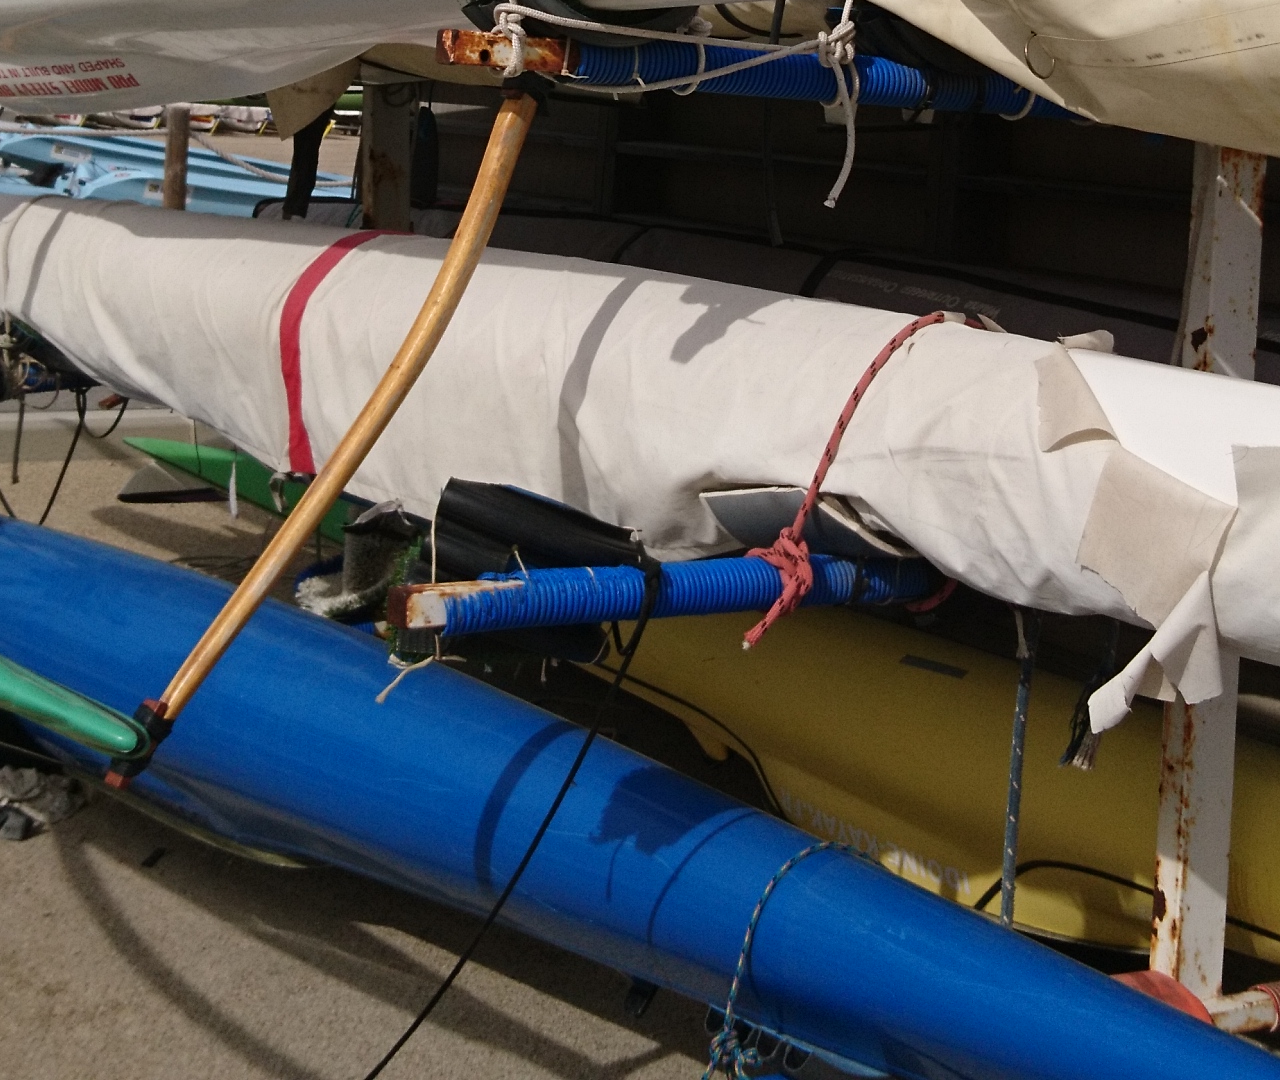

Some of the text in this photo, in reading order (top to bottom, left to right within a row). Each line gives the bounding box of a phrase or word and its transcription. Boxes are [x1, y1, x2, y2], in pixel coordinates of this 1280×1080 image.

[21, 65, 51, 77] BUILT
[51, 64, 76, 74] AND
[78, 57, 126, 73] SHAPED
[8, 68, 20, 78] IN
[61, 77, 110, 94] MODEL
[106, 73, 141, 90] PRO
